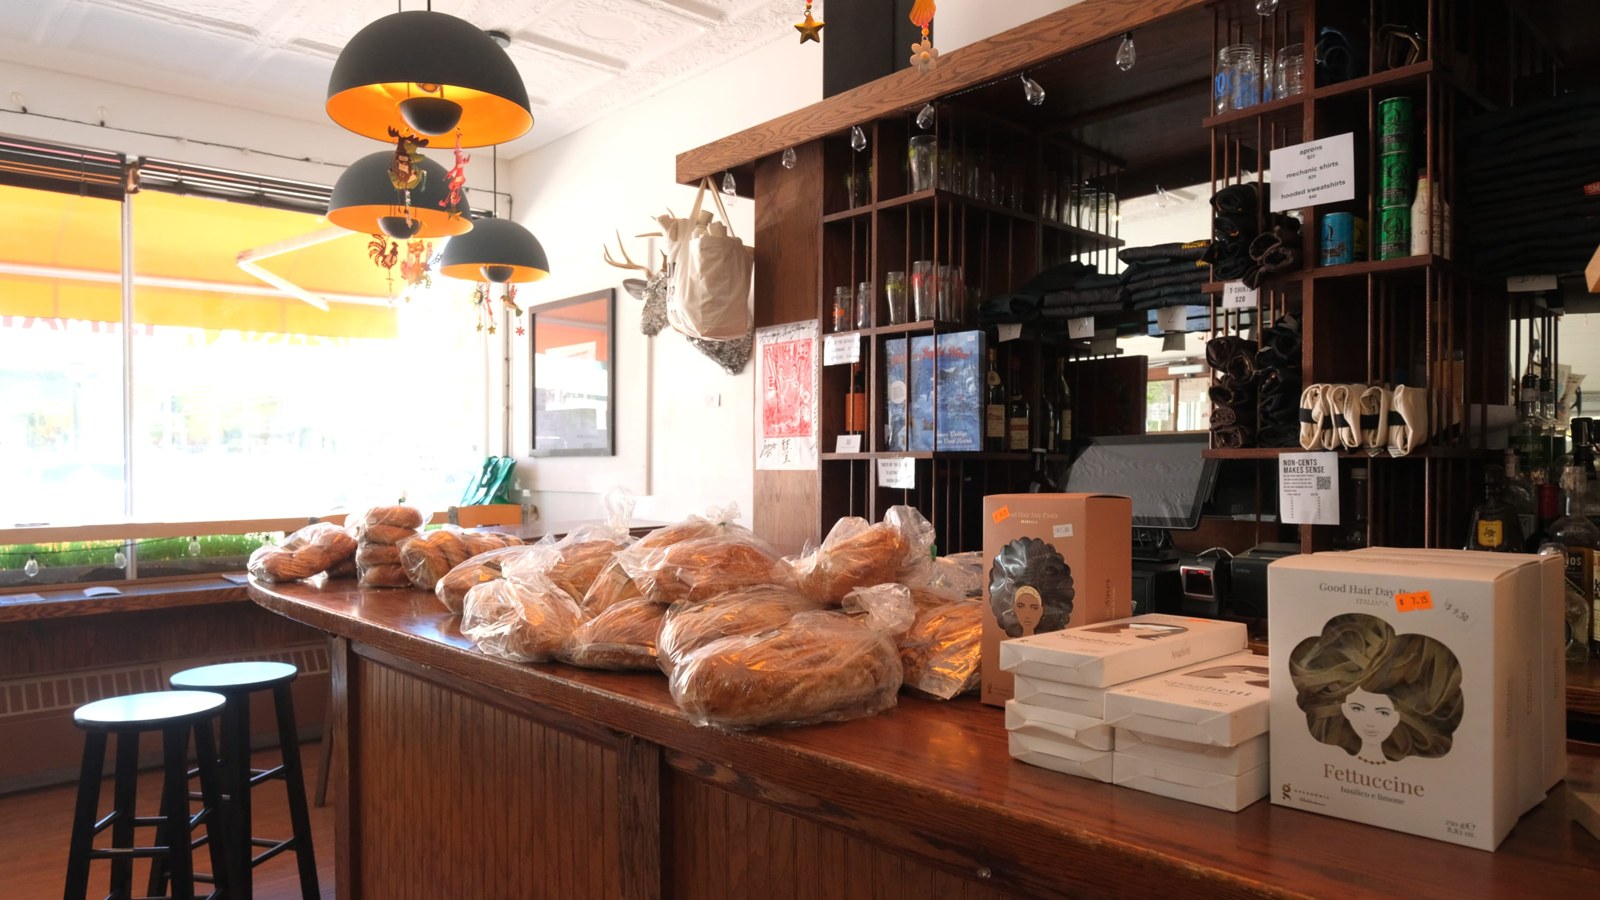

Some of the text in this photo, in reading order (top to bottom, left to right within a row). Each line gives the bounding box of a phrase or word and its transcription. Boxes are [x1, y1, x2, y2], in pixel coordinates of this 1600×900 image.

[1299, 145, 1323, 156] aprons
[1286, 161, 1339, 179] mechanic shirts
[1280, 180, 1346, 200] hooded sweatshirts
[1283, 459, 1317, 467] NON-CENTS
[1305, 466, 1325, 474] SENSE
[1319, 582, 1346, 594] Good
[1349, 584, 1373, 596] Hair
[1375, 586, 1396, 598] Day
[1323, 763, 1425, 798] Fettuccine
[1340, 785, 1370, 799] basilico
[1377, 793, 1405, 805] limone
